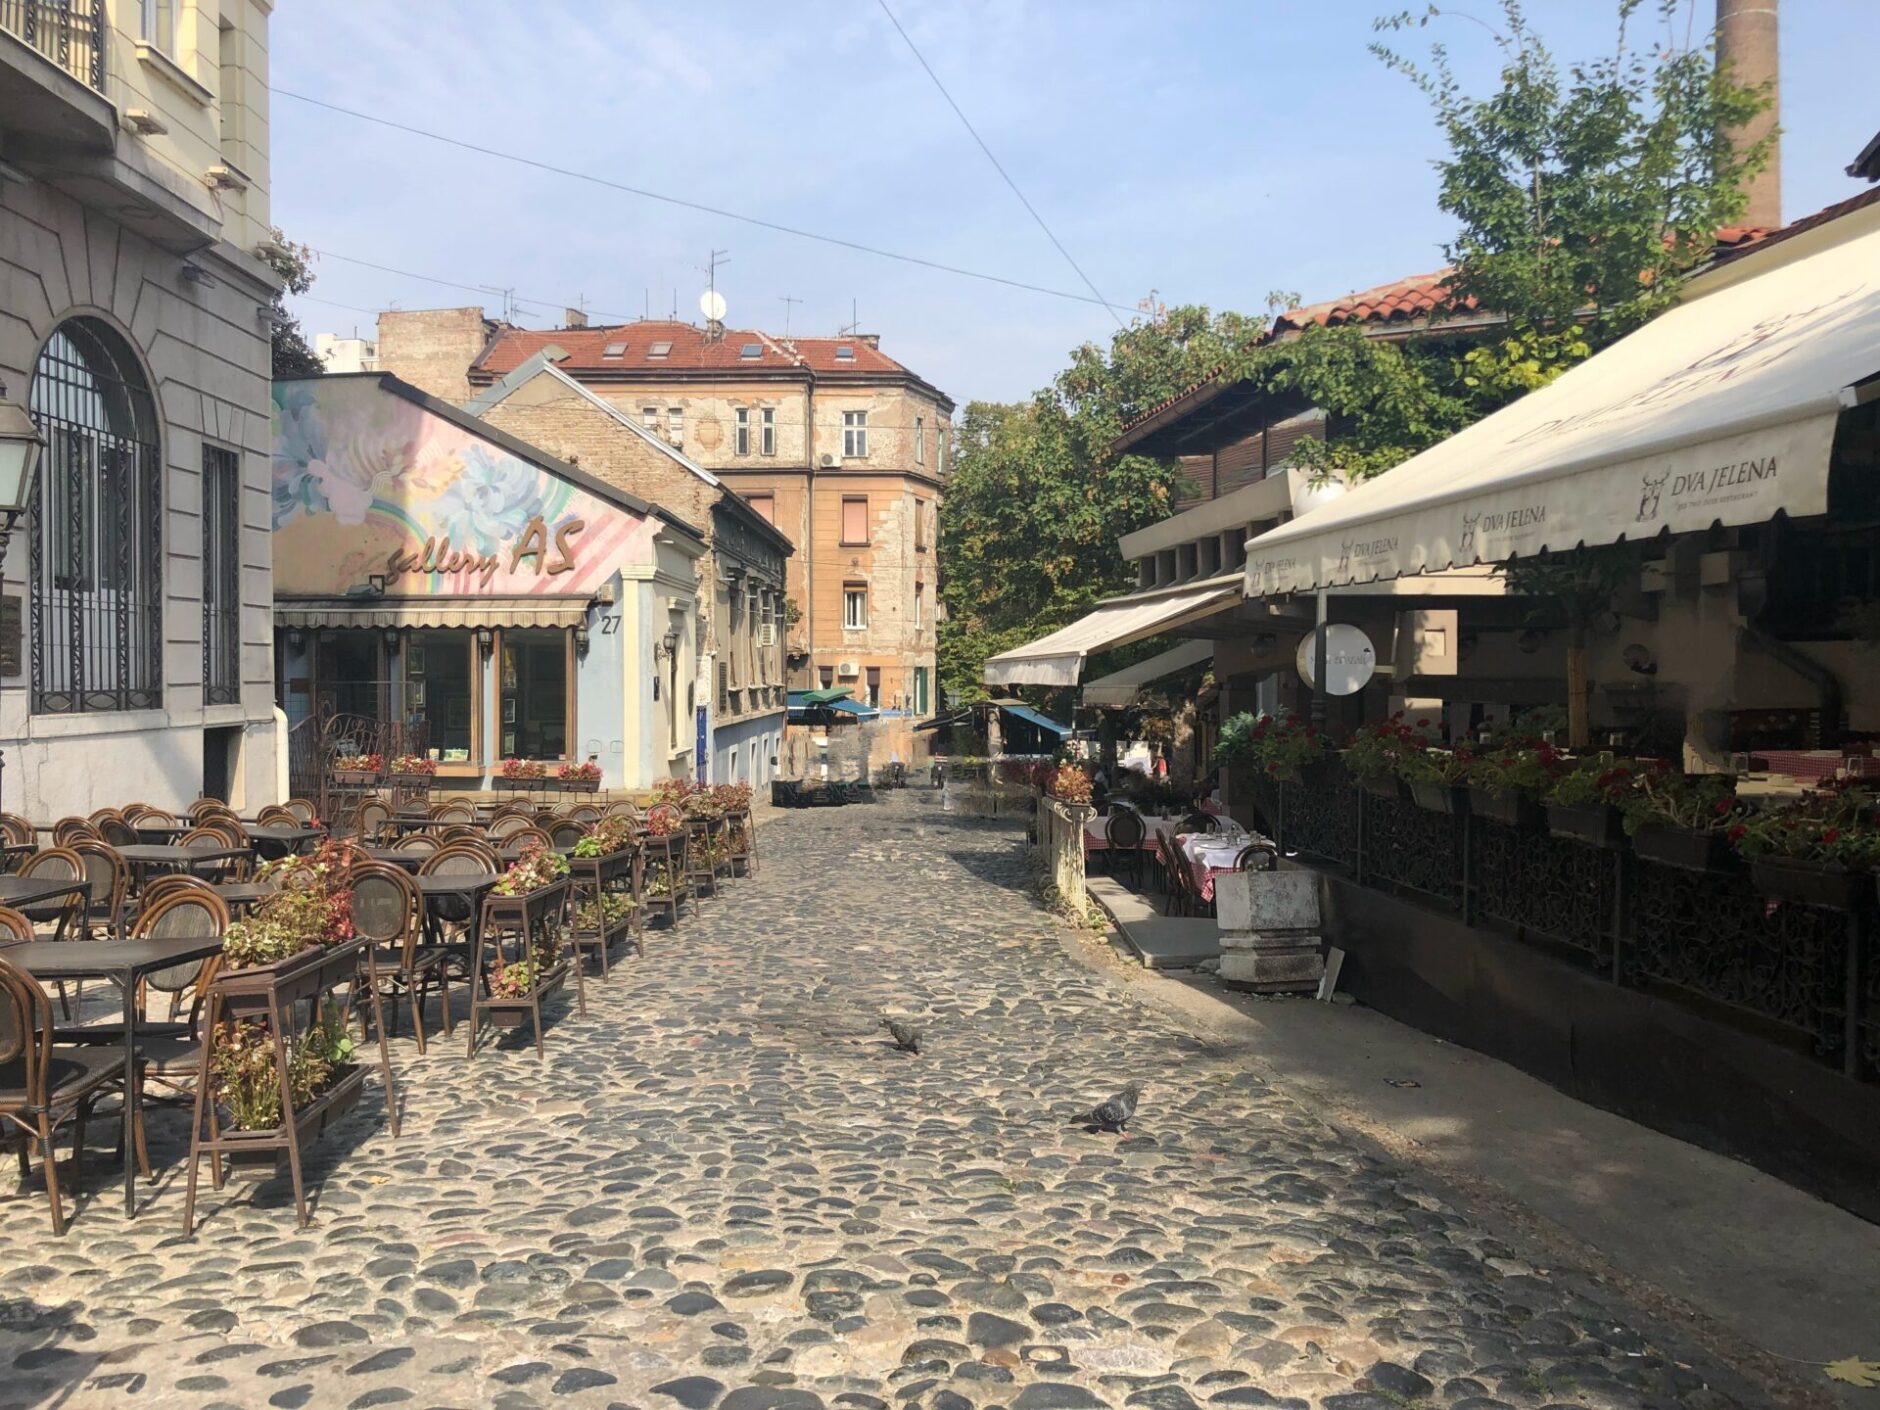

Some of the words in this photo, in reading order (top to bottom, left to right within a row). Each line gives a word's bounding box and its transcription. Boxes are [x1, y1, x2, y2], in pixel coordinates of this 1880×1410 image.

[1671, 470, 1705, 496] DVA
[1707, 456, 1777, 495] JELENA
[1482, 514, 1504, 533] DVA
[1503, 505, 1546, 533] JELENA
[510, 515, 585, 575] AS
[601, 615, 622, 635] 27
